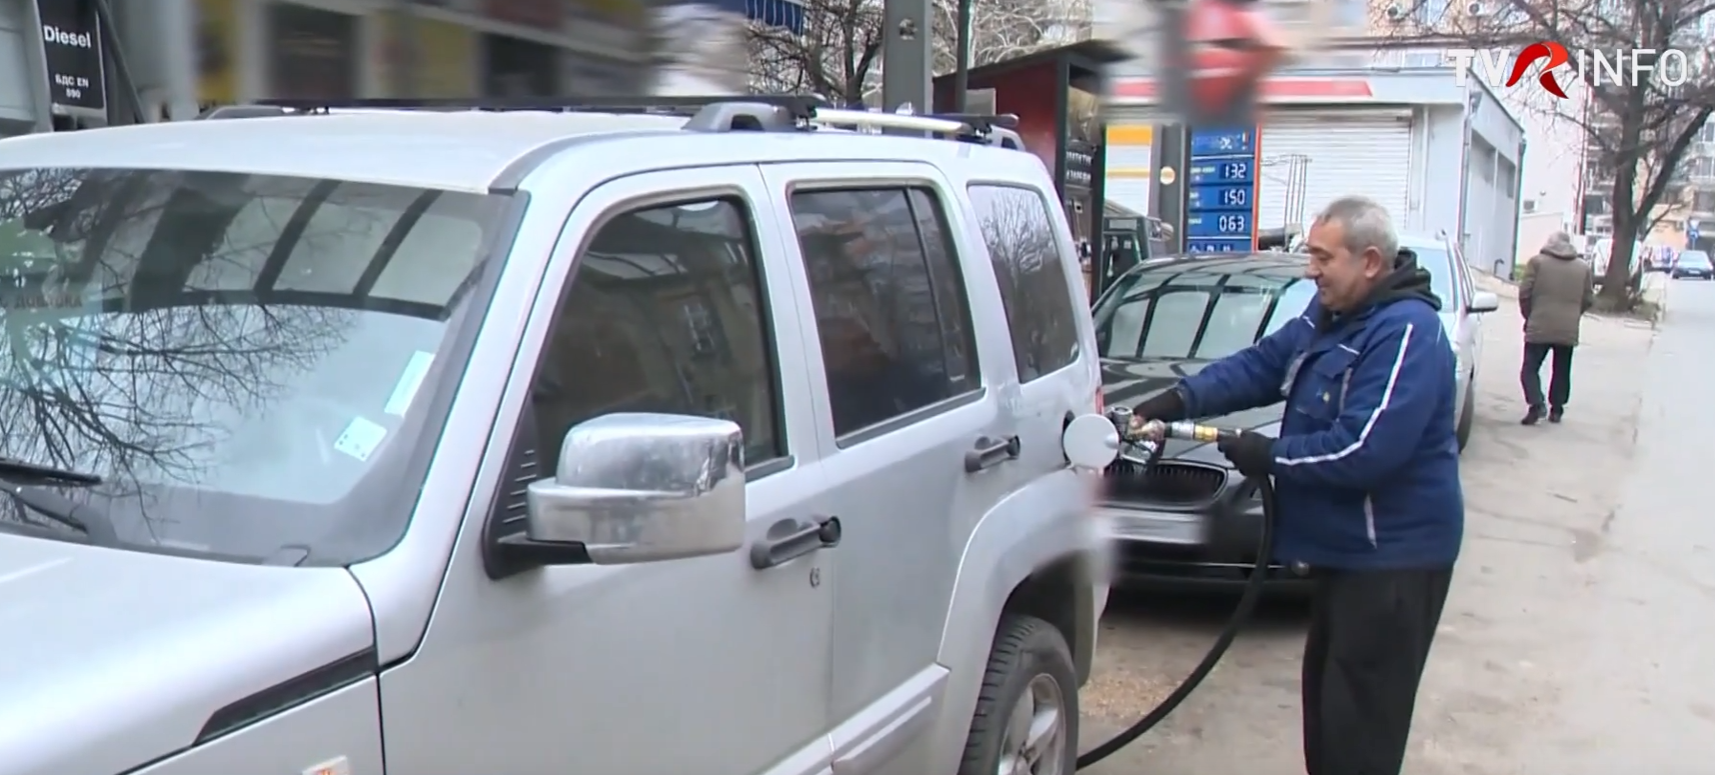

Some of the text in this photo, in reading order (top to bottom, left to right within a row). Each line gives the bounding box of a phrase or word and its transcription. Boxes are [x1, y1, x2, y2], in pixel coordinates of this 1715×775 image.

[44, 24, 91, 48] Diesel
[76, 77, 89, 88] EN
[1225, 163, 1246, 179] 132
[1224, 189, 1245, 205] 150
[1219, 215, 1245, 232] 063
